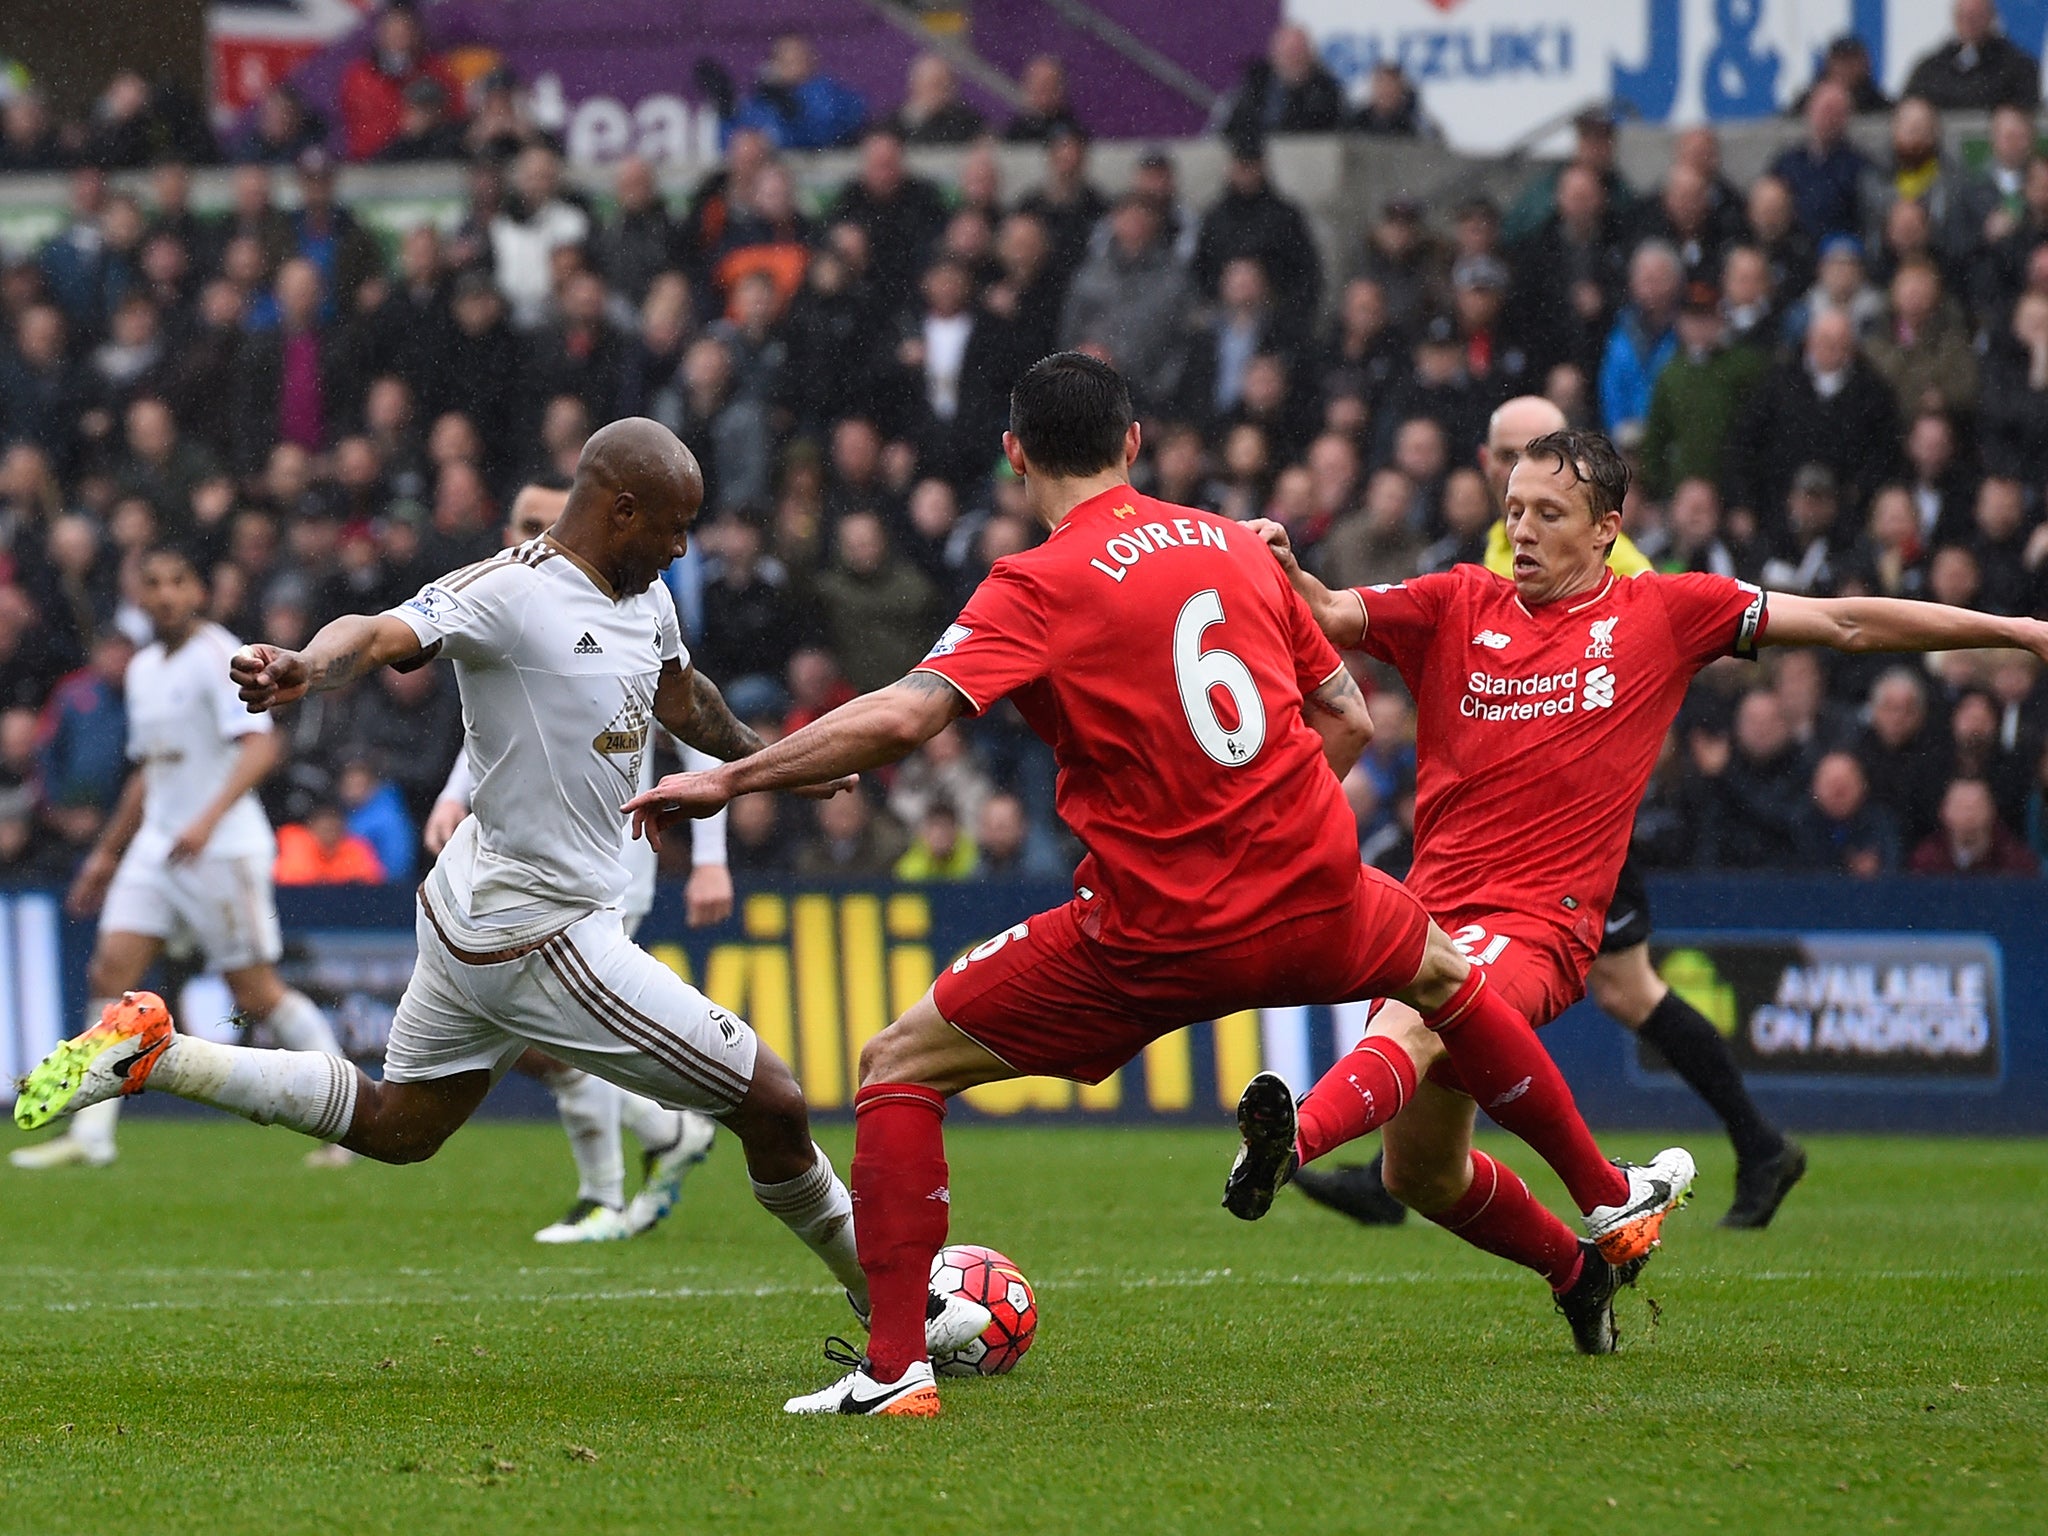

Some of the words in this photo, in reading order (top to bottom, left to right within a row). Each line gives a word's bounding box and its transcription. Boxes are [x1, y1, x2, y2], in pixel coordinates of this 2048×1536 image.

[1090, 518, 1229, 583] LOVREN
[573, 645, 603, 654] adidas
[1172, 588, 1267, 768] 6
[1468, 667, 1578, 696] Standard
[1459, 691, 1575, 722] Chartered
[1451, 924, 1512, 965] 21
